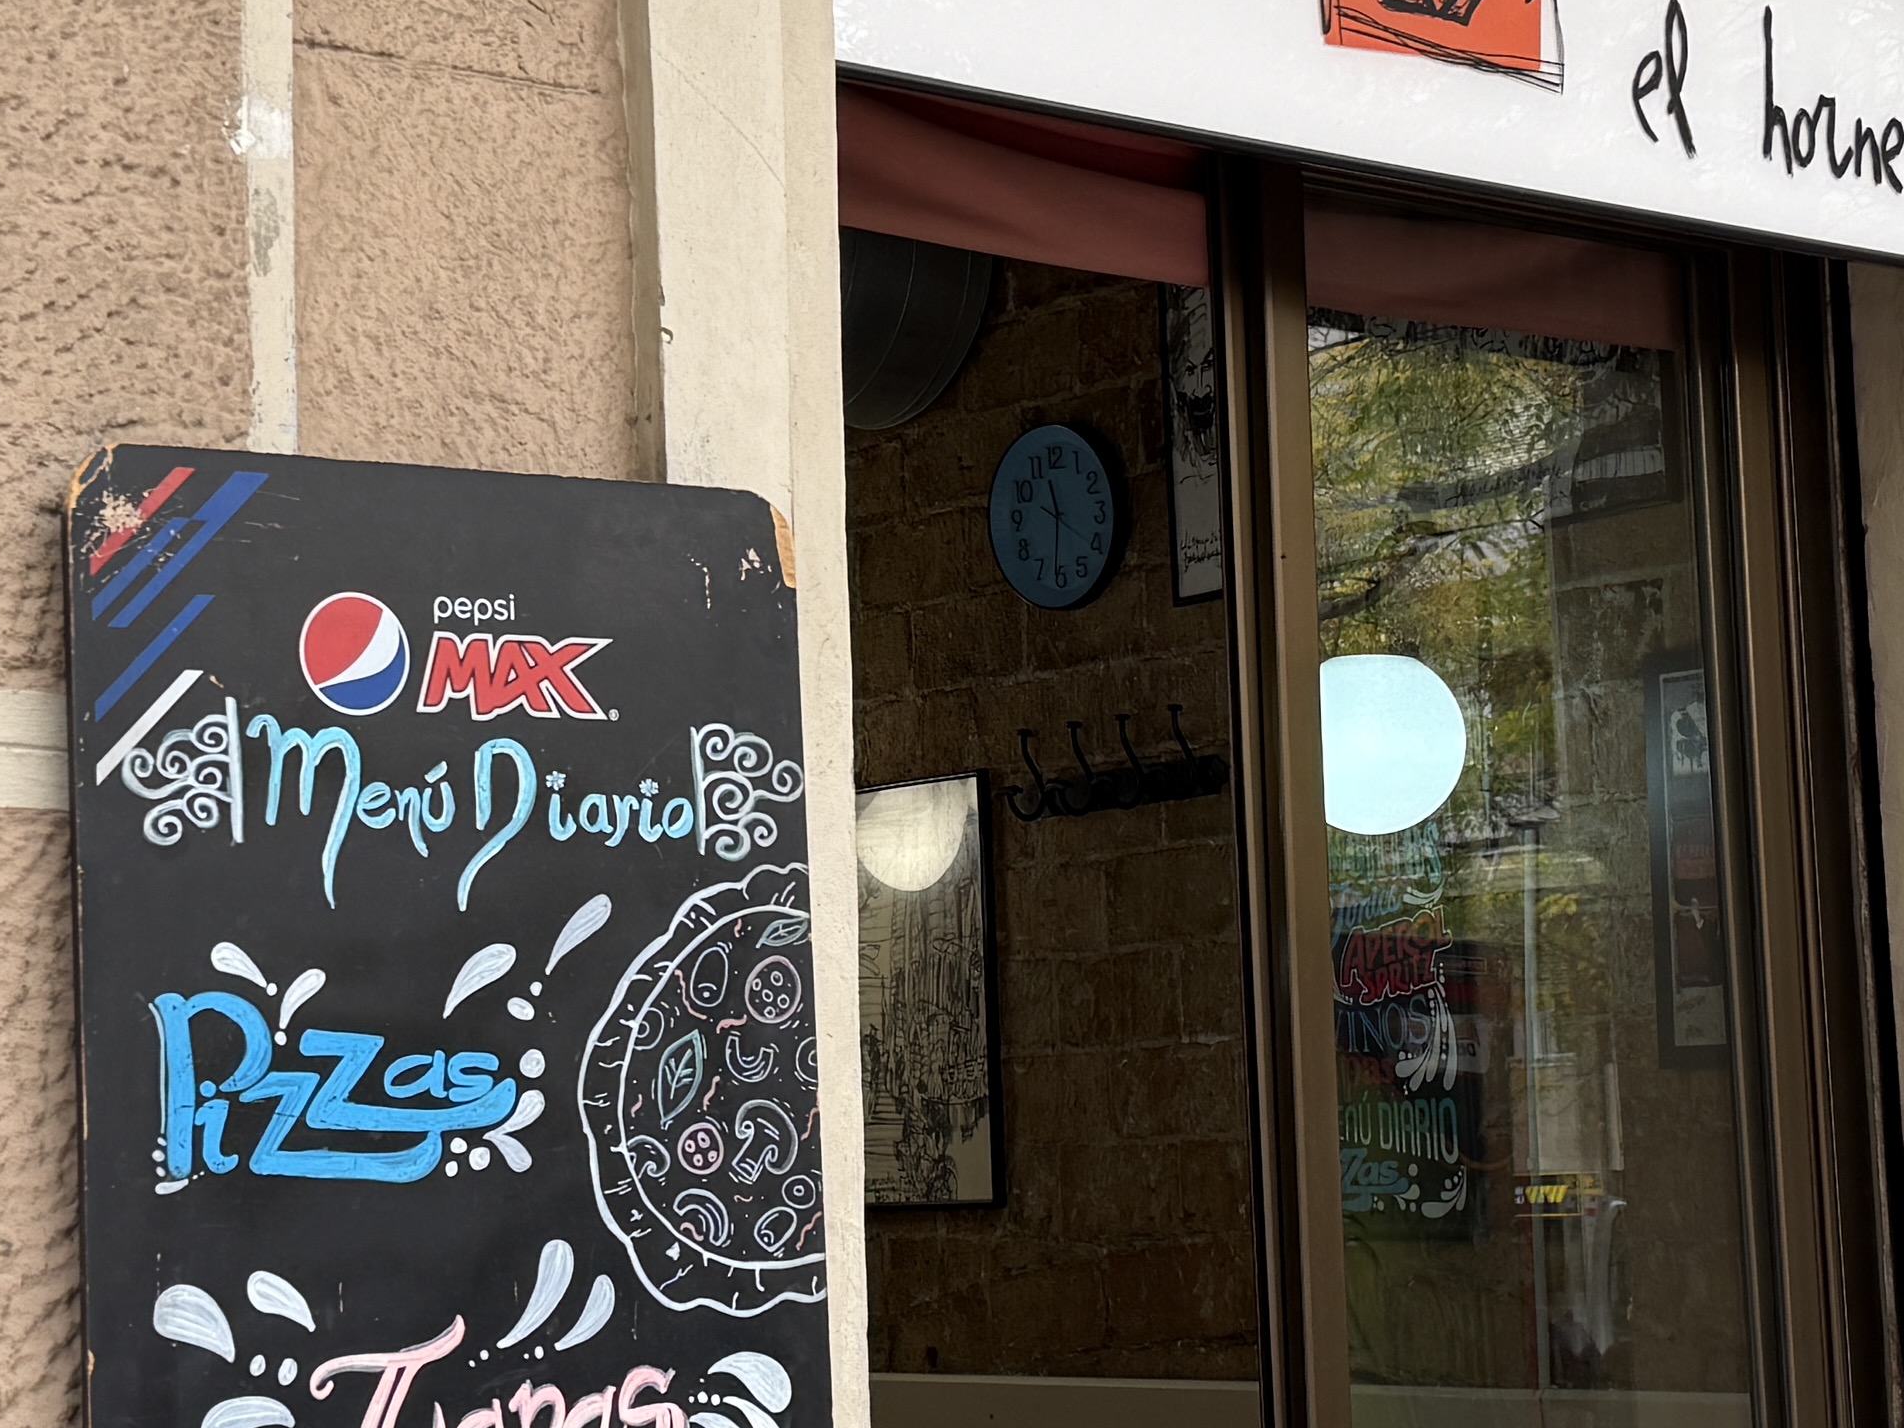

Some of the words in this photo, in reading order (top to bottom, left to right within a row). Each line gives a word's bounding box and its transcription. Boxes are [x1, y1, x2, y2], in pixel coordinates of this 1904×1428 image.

[1029, 455, 1043, 479] 11
[1046, 445, 1067, 469] 12
[1015, 479, 1034, 503] 10
[1086, 471, 1100, 495] 2
[1011, 509, 1023, 532] 9
[1093, 501, 1106, 524] 3
[1018, 538, 1030, 561] 8
[1090, 532, 1104, 555] 4
[1034, 558, 1045, 581] 7
[1056, 565, 1068, 589] 6
[1076, 556, 1089, 578] 5
[433, 593, 516, 623] pepsi
[416, 630, 614, 722] MAX
[246, 714, 457, 910] Menú
[456, 737, 695, 913] Diario
[1378, 1097, 1460, 1164] DIARIO
